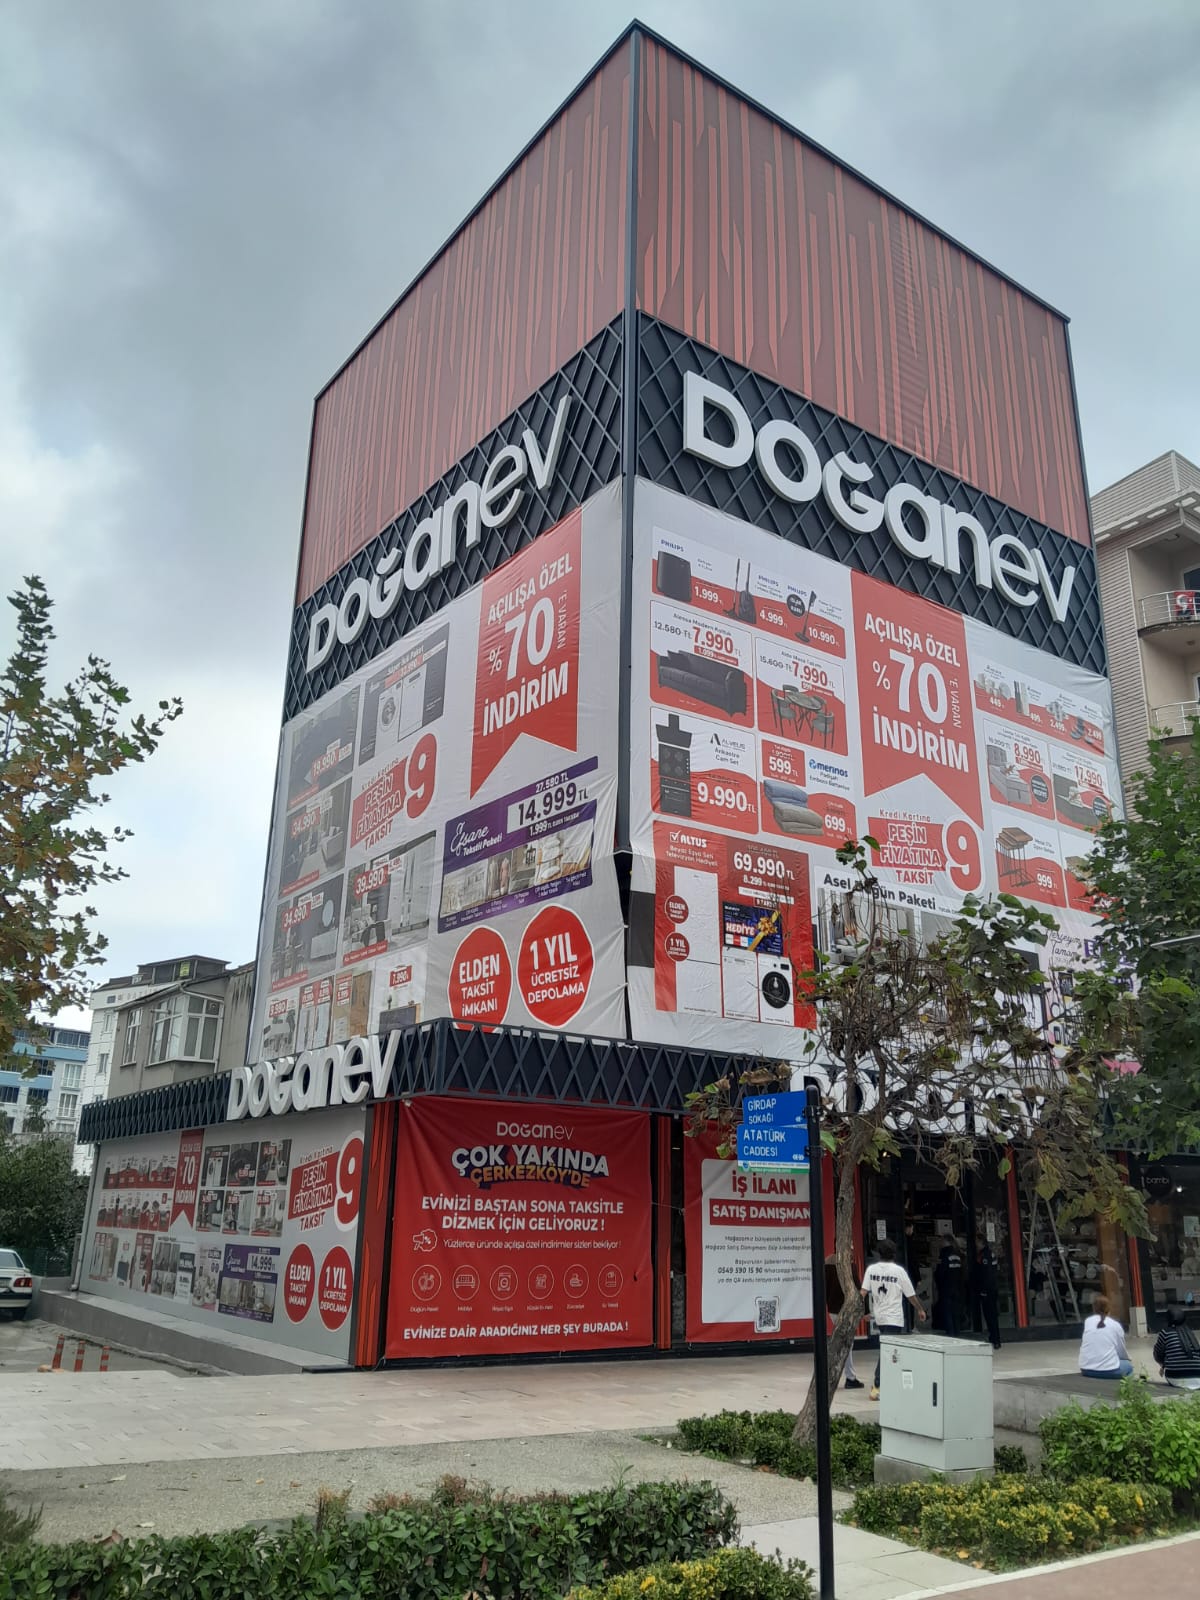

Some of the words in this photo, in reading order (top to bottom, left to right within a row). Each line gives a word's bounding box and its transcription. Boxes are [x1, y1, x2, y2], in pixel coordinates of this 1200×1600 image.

[661, 539, 685, 552] PHILIPS
[487, 577, 536, 625] AÇILIŞA
[539, 551, 573, 591] ÖZEL
[694, 586, 718, 604] 1.999
[556, 606, 569, 649] VARAN
[760, 610, 784, 626] 4.999
[693, 626, 734, 654] 7.990
[808, 627, 835, 645] 10.990
[864, 612, 923, 654] AÇILIŞA
[926, 633, 961, 667] ÖZEL
[792, 661, 828, 687] 7.990
[482, 661, 570, 736] İNDİRİM
[950, 691, 962, 728] VARAN
[873, 706, 969, 774] İNDİRİM
[1013, 743, 1041, 764] 8.990
[406, 733, 437, 819] 9
[769, 756, 791, 775] 599
[817, 761, 848, 778] merinos
[518, 782, 577, 826] 14.999
[579, 788, 589, 801] TL
[697, 782, 747, 812] 9.990
[747, 804, 757, 814] TL
[356, 790, 402, 841] FİYATINA
[825, 814, 846, 833] 699
[879, 808, 900, 820] Kredi
[903, 811, 931, 823] Kartına
[365, 818, 394, 851] TAKSİT
[463, 839, 483, 857] Tekstil
[483, 831, 504, 848] Paketi
[680, 834, 707, 848] ALTUS
[887, 822, 928, 847] PEŞİN
[733, 851, 785, 879] 69.990
[786, 869, 796, 882] TL
[879, 843, 942, 868] FİYATINA
[946, 819, 982, 892] 9
[356, 868, 385, 894] 39.990
[896, 869, 934, 885] TAKSİT
[1037, 873, 1053, 889] 999
[824, 873, 850, 890] Asel
[900, 892, 936, 911] Paketi
[726, 922, 755, 936] HEDİYE
[530, 940, 539, 970] 1
[544, 932, 578, 967] YIL
[675, 938, 687, 948] YIL
[459, 953, 500, 984] ELDEN
[531, 964, 580, 987] ÜCRETSİZ
[461, 979, 495, 1000] TAKSİT
[527, 982, 585, 1005] DEPOLAMA
[461, 998, 498, 1017] İMKANI
[748, 1098, 777, 1112] GİRDAP
[749, 1113, 774, 1124] SOKAĞI
[744, 1128, 786, 1143] ATATÜRK
[452, 1145, 504, 1177] ÇOK
[512, 1145, 609, 1177] YAKINDA
[744, 1146, 778, 1157] CADDESİ
[302, 1160, 328, 1188] PEŞİN
[337, 1137, 364, 1225] 9
[470, 1162, 591, 1188] ÇERKEZKÖY'DE
[732, 1169, 748, 1197] İŞ
[753, 1172, 797, 1195] İLANI
[292, 1183, 333, 1214] FİYATINA
[422, 1193, 471, 1211] EVİNİZİ
[475, 1199, 527, 1215] BAŞTAN
[530, 1200, 566, 1213] SONA
[569, 1198, 624, 1214] TAKSİTLE
[300, 1209, 326, 1232] TAKSİT
[442, 1212, 495, 1230] DİZMEK
[499, 1213, 525, 1233] İÇİN
[529, 1214, 597, 1231] GELİYORUZ
[712, 1204, 747, 1221] SATIŞ
[443, 1239, 475, 1249] Yüzlerce
[476, 1240, 503, 1249] üründe
[504, 1240, 525, 1251] açılışa
[526, 1239, 540, 1248] özel
[541, 1239, 573, 1249] indirimler
[251, 1255, 273, 1271] 14.999
[289, 1264, 311, 1282] ELDEN
[290, 1282, 307, 1294] TAKSİT
[326, 1266, 331, 1288] 1
[333, 1266, 347, 1290] YIL
[323, 1288, 347, 1303] ÜCRETSİZ
[320, 1301, 348, 1314] DEPOLAMA
[403, 1324, 446, 1340] EVİNİZE
[450, 1323, 477, 1338] DAİR
[479, 1323, 538, 1338] ARADIĞINIZ
[540, 1323, 560, 1335] HER
[563, 1323, 580, 1336] ŞEY
[583, 1321, 623, 1333] BURADA
